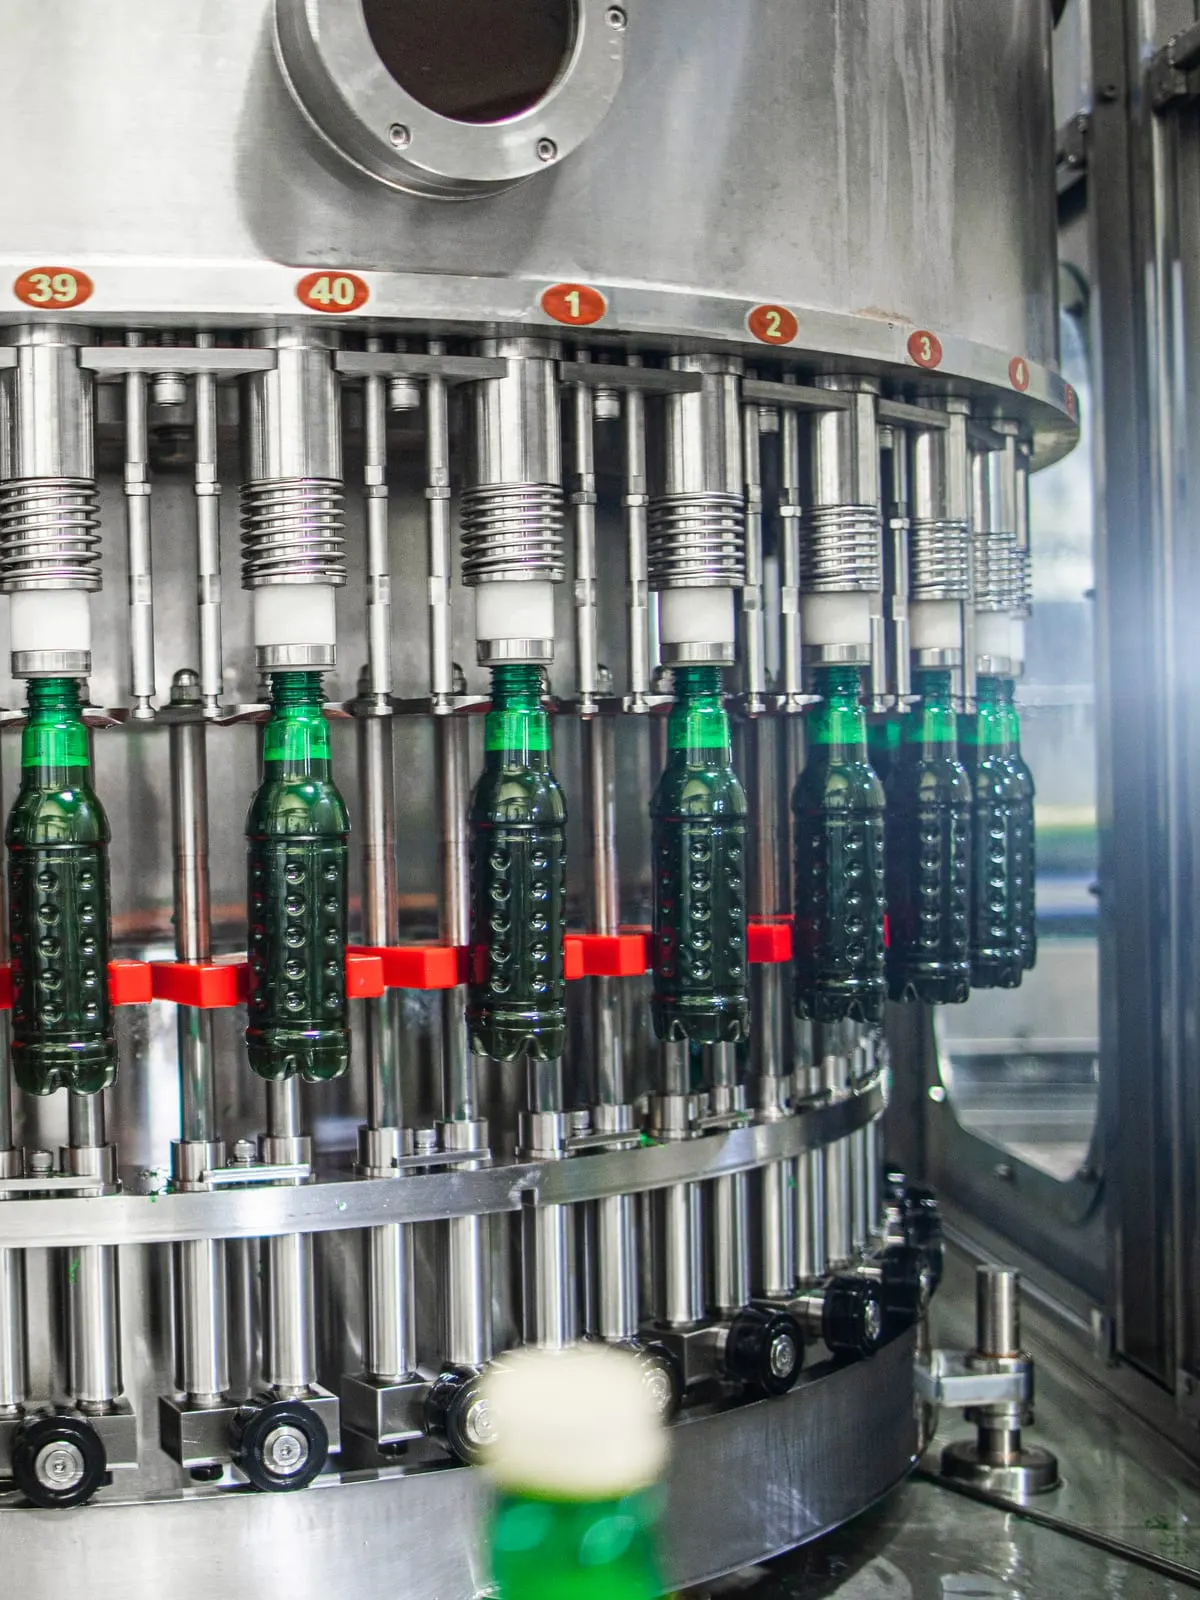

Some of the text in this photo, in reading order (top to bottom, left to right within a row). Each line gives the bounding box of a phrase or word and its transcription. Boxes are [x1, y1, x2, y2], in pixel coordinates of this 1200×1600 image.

[28, 273, 77, 302] 39
[308, 276, 355, 305] 40
[564, 290, 580, 318] 1
[766, 311, 782, 338] 2
[920, 336, 932, 361] 3
[1015, 363, 1024, 385] 4
